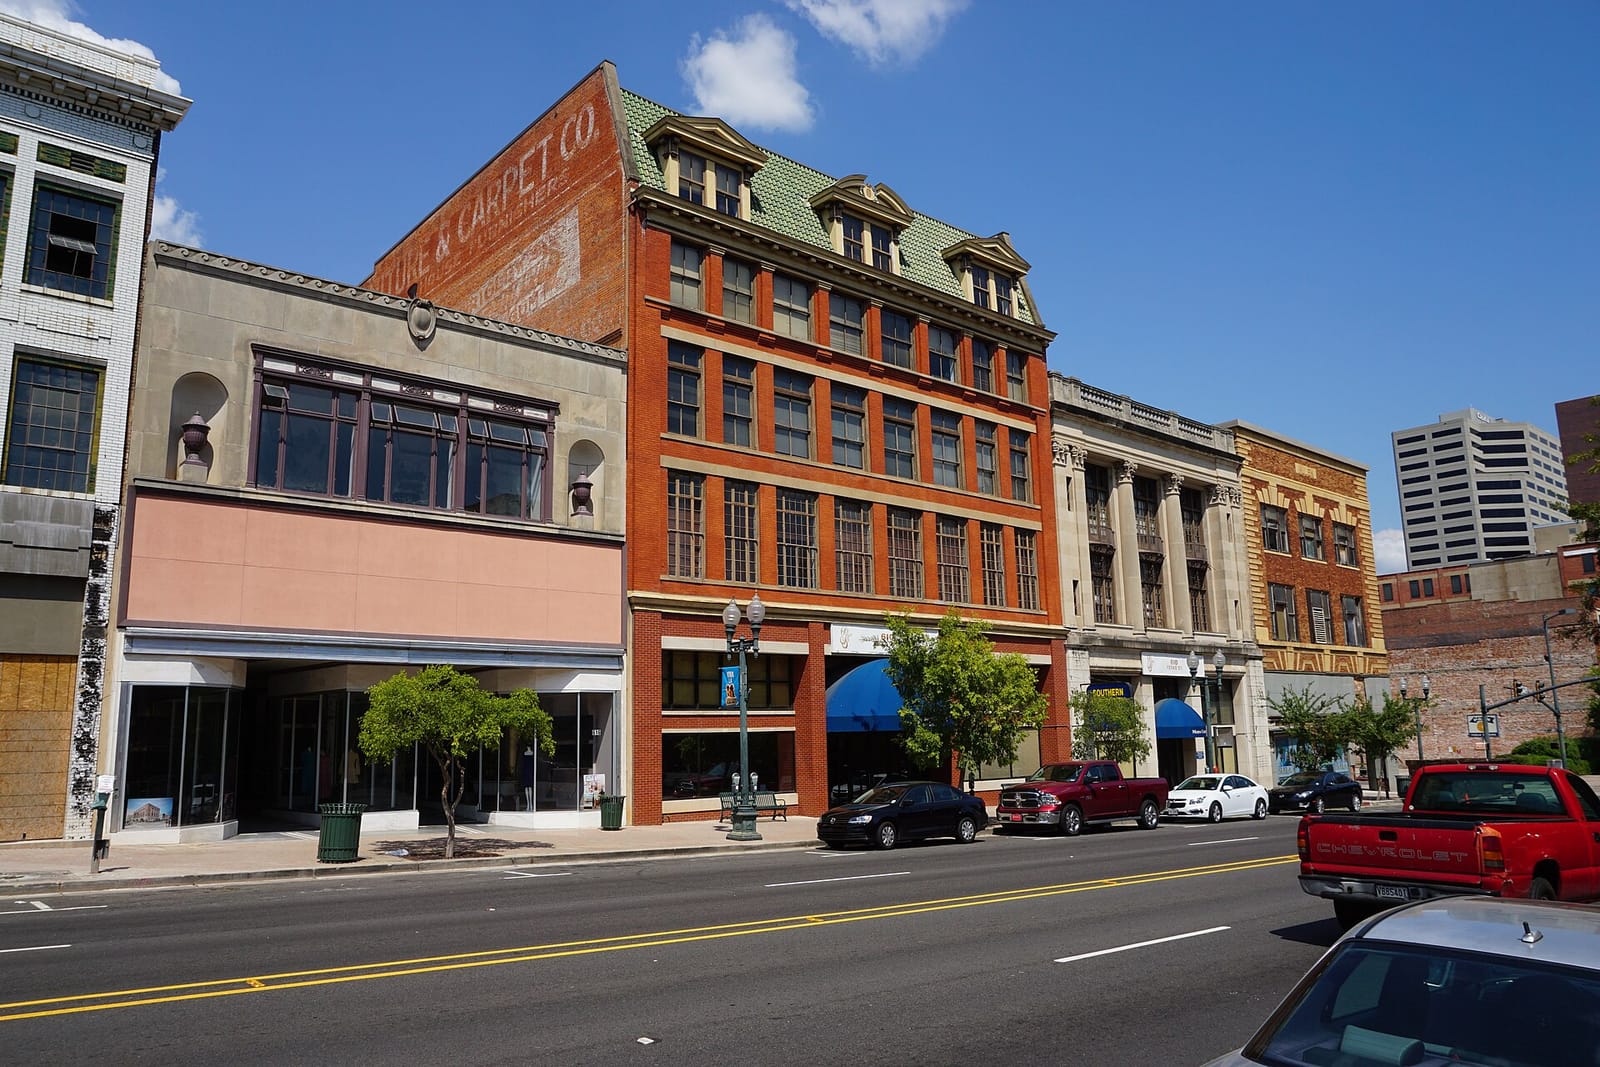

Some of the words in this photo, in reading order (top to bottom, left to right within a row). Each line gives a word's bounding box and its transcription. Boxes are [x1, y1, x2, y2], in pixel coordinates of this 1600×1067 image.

[435, 222, 450, 262] &
[457, 133, 554, 243] CARPET
[1092, 687, 1124, 698] SOUTHERN
[1316, 842, 1469, 863] CHEVROLET
